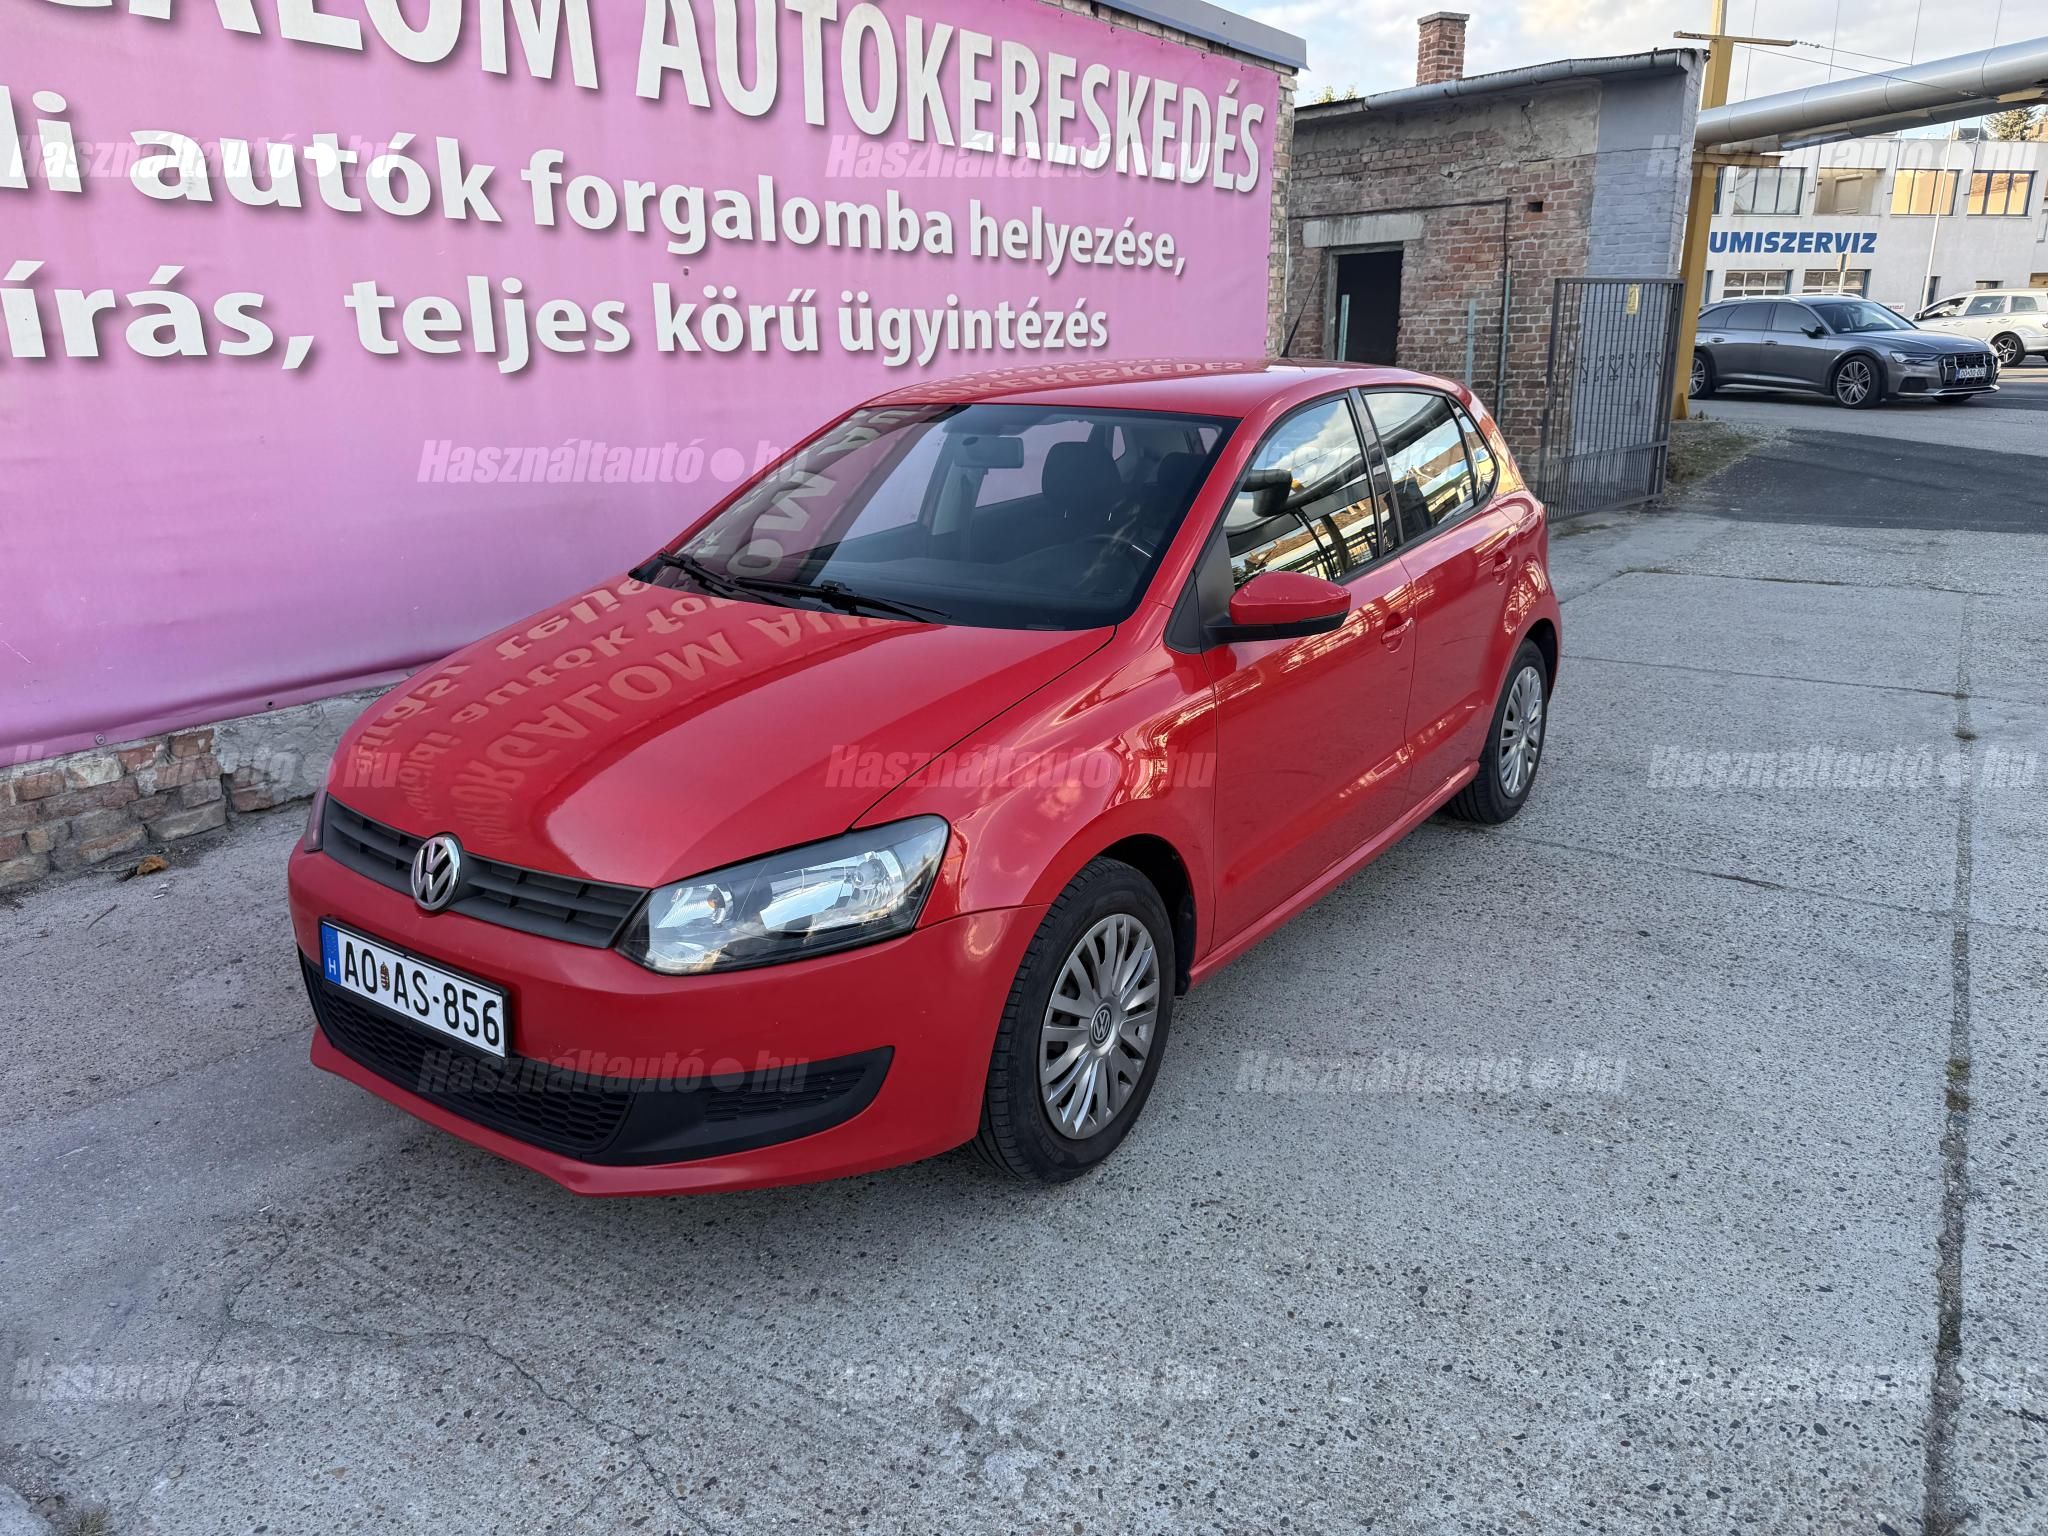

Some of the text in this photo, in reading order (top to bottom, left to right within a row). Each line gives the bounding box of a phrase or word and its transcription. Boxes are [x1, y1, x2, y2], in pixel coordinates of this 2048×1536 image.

[128, 129, 502, 222] autók
[520, 149, 952, 254] forgalomba
[969, 198, 1184, 275] helyezése,
[343, 275, 630, 374] teljes
[652, 282, 818, 351] körű
[838, 289, 1107, 366] ügyintézés
